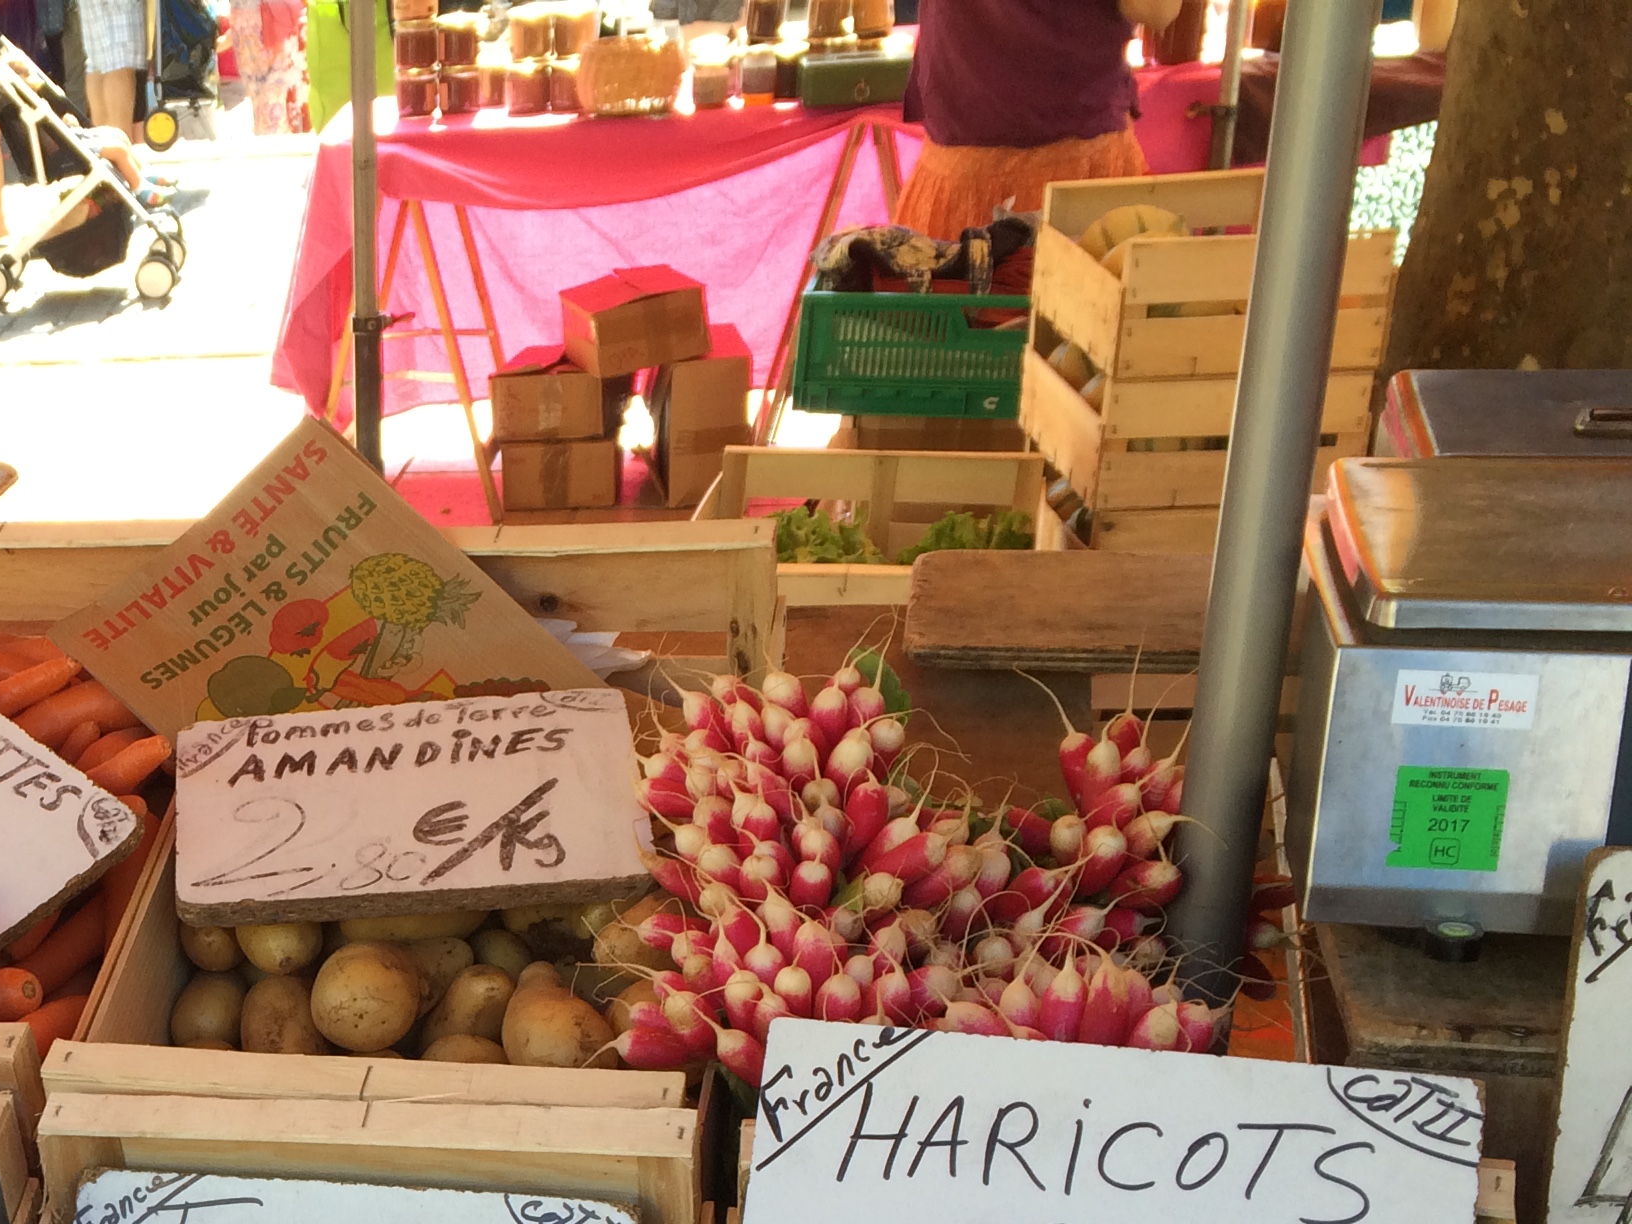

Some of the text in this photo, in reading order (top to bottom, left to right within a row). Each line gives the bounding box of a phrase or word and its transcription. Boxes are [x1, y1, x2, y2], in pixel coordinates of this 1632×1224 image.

[81, 439, 329, 652] SANTÉ & VITALITÉ
[139, 491, 377, 690] FRUITS & LÉGUMES
[188, 533, 286, 628] par jour
[1472, 699, 1485, 710] DE
[1487, 688, 1529, 713] PESAGE
[404, 707, 442, 730] de
[1409, 779, 1499, 791] RECONNU CONFORME
[1429, 771, 1482, 781] INSTRUMENT
[1432, 794, 1472, 803] LIMITE DE
[1427, 818, 1471, 832] 2017
[1434, 845, 1457, 858] HC
[761, 1026, 914, 1140] France
